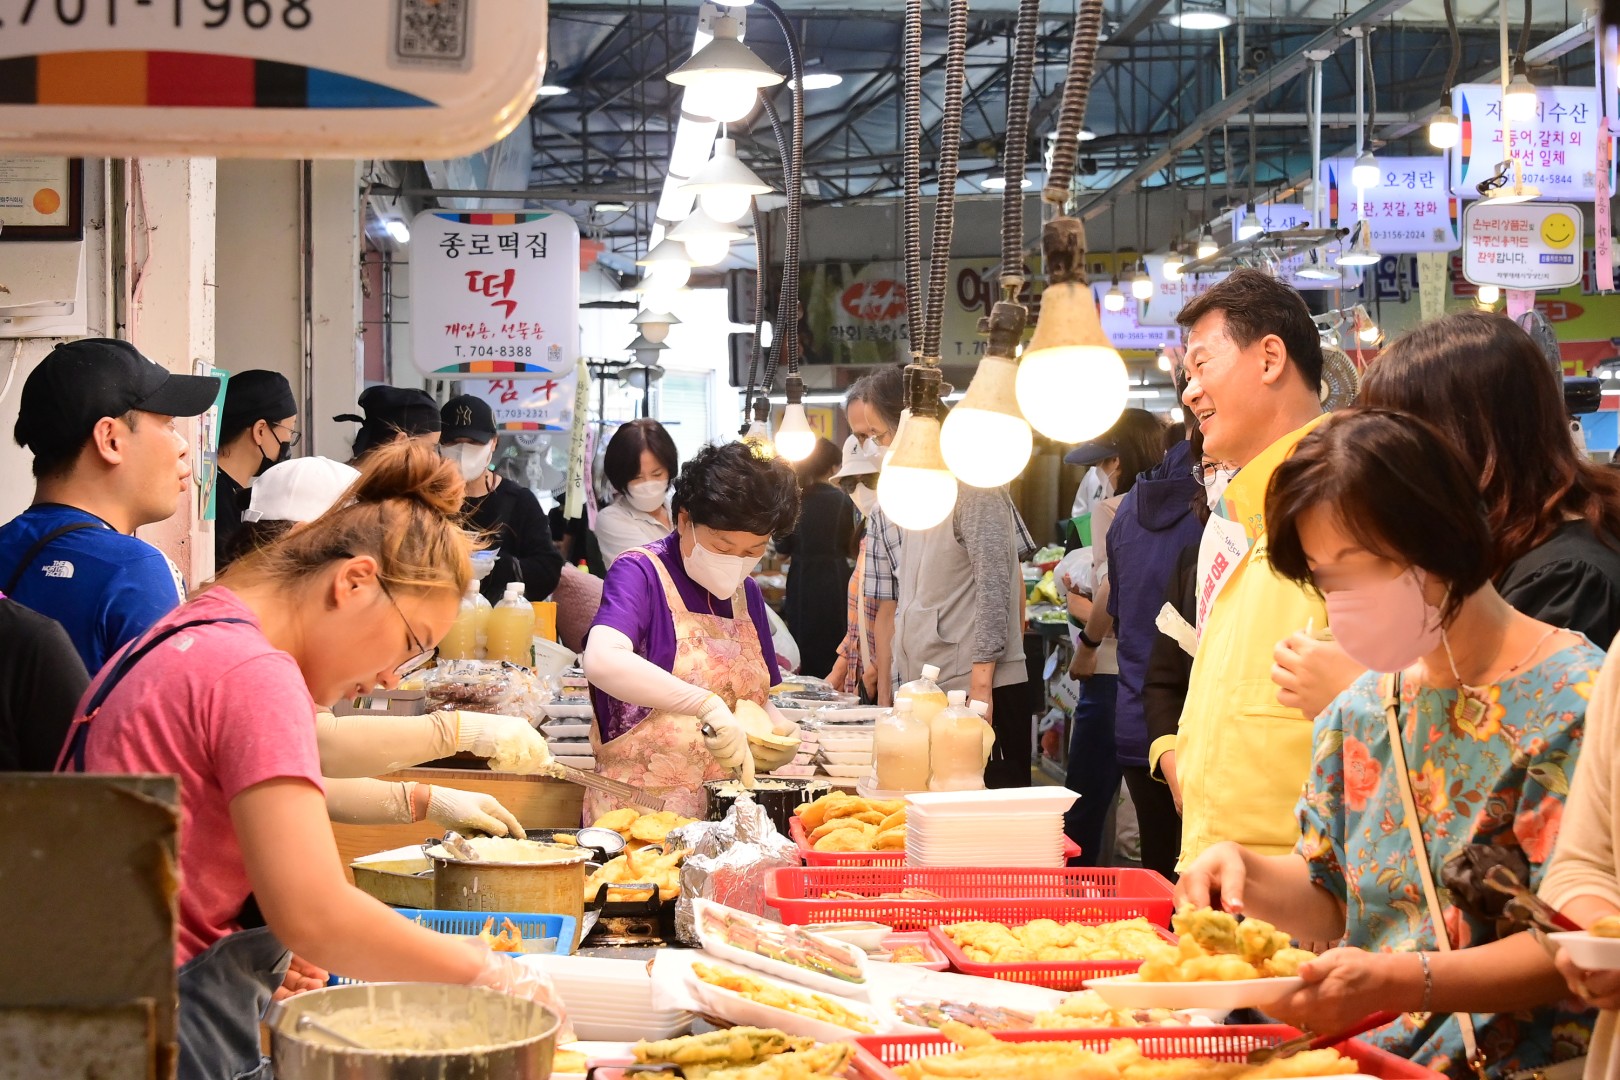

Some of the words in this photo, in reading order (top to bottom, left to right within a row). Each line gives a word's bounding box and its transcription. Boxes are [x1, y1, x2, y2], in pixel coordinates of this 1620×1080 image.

[1486, 100, 1589, 124] 자수산
[1569, 131, 1581, 146] 외
[1539, 150, 1565, 167] 일체
[1414, 201, 1437, 217] 잡화
[439, 231, 547, 259] 종로떡집
[1477, 251, 1527, 265] 환영합니다.
[464, 268, 518, 320] 떡
[444, 322, 495, 341] 개업용,
[501, 322, 545, 341] 선물용
